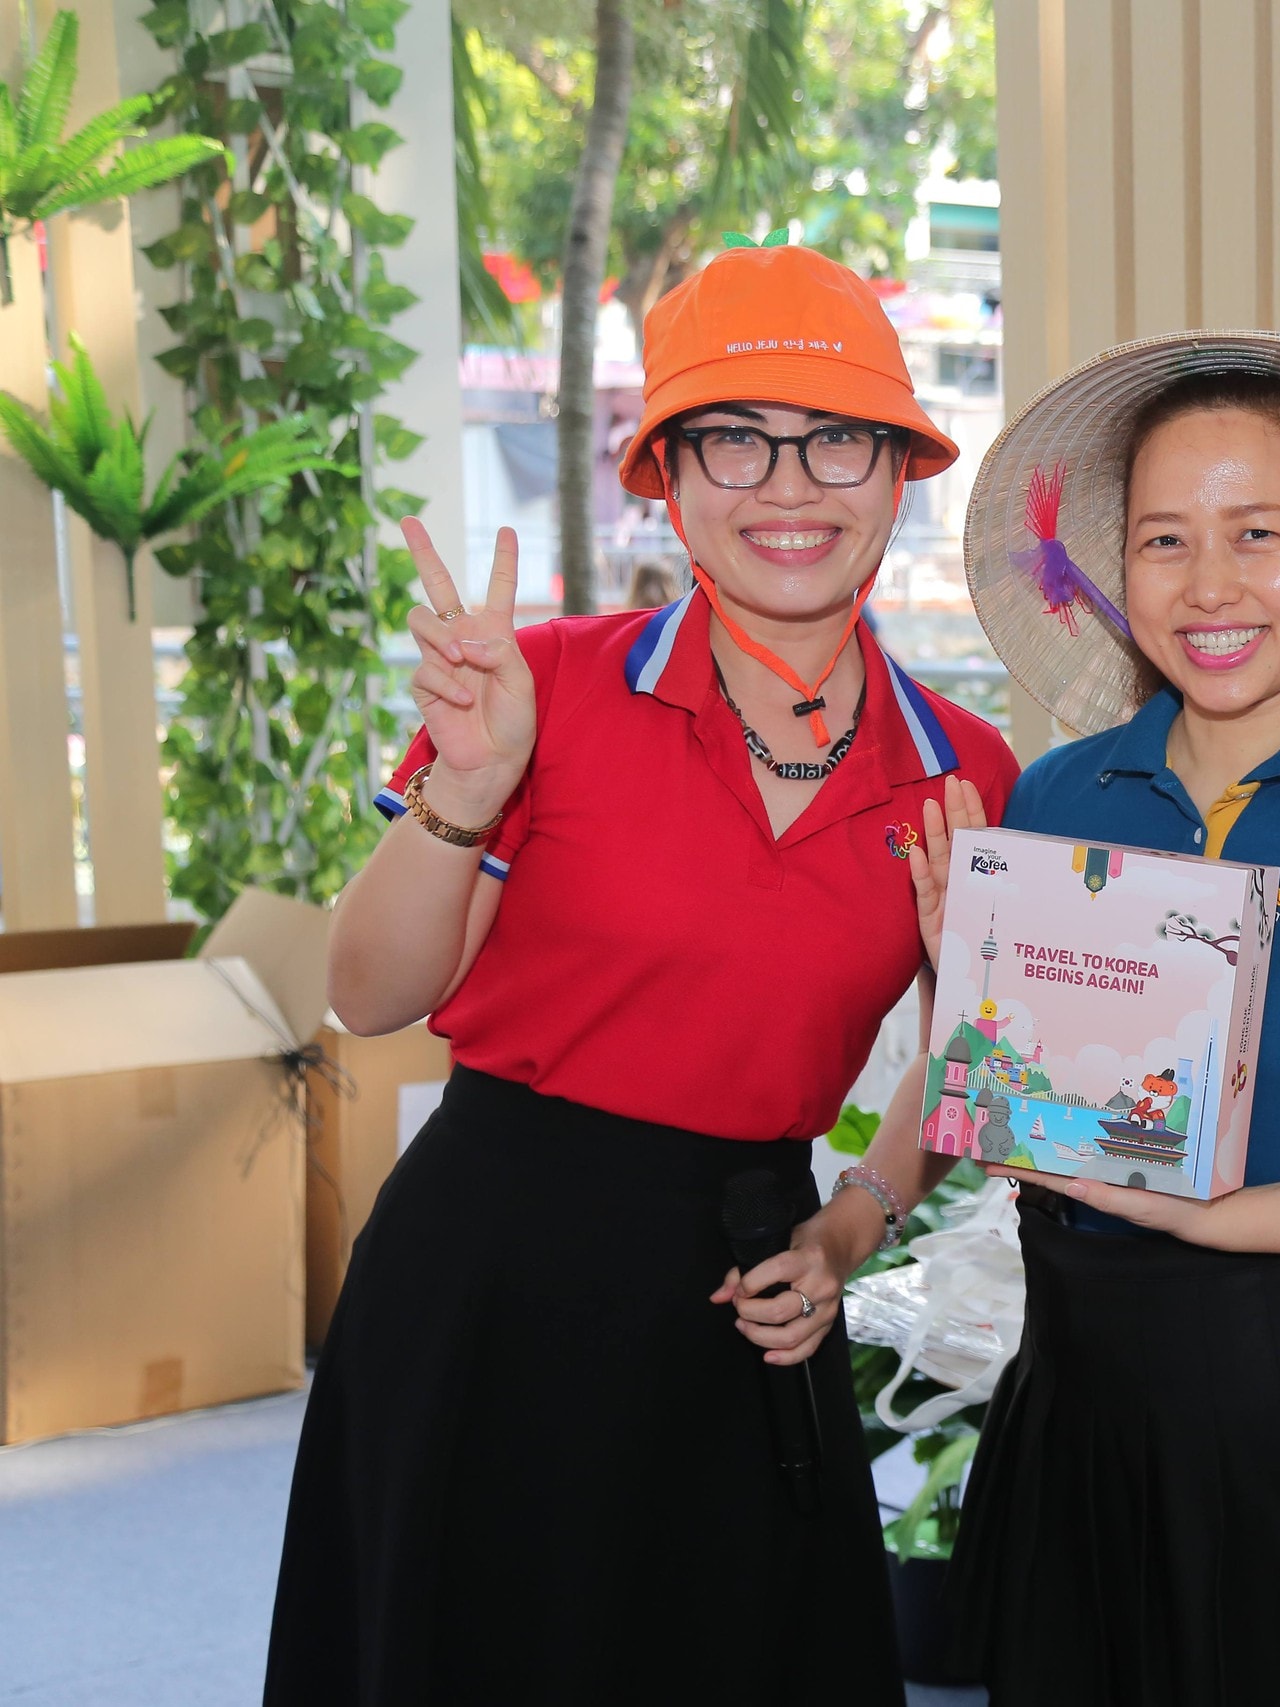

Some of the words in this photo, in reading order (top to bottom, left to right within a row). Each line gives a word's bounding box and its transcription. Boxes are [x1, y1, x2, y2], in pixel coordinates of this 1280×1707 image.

[726, 342, 752, 353] HELLO
[755, 340, 778, 350] JEJU
[973, 846, 997, 855] Imagine
[971, 856, 1008, 873] Korea
[1014, 943, 1077, 966] TRAVEL
[1082, 953, 1102, 969] TO
[1104, 956, 1159, 978] KOREA
[1024, 963, 1084, 986] BEGINS
[1086, 973, 1144, 995] AGAIN!
